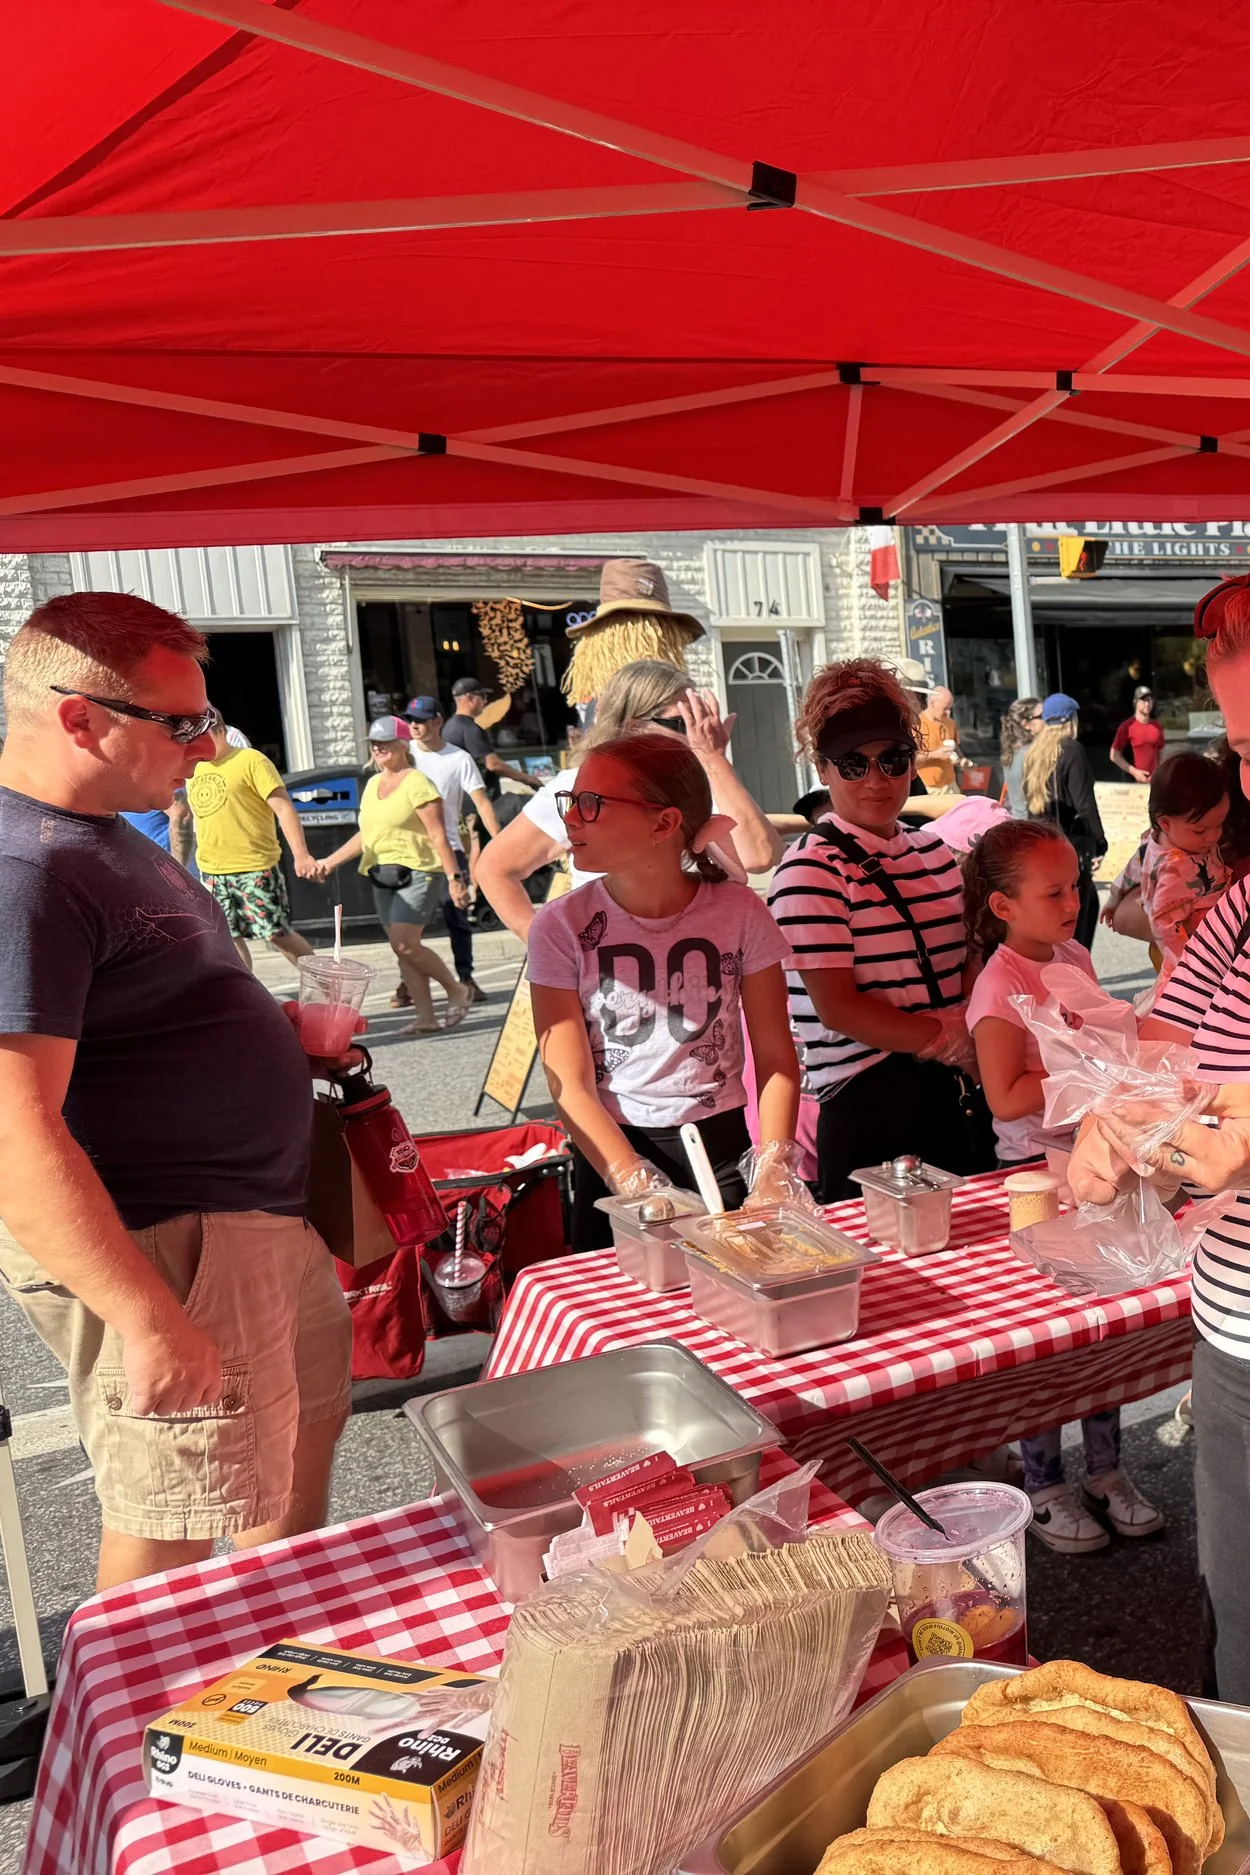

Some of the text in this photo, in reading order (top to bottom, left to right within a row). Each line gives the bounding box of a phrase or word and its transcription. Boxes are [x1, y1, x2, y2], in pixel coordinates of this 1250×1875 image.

[1152, 541, 1231, 556] LIGHTS
[753, 599, 780, 617] 74
[597, 937, 722, 1047] DO
[588, 1463, 641, 1493] BEAVERTAILS
[603, 1481, 656, 1507] BEAVERTAILS
[255, 1663, 293, 1674] RHINO
[262, 1723, 299, 1737] Gloves
[267, 1717, 371, 1743] GANTS DE CHARCUTERIE
[150, 1745, 177, 1765] Rhino
[189, 1741, 267, 1766] Medium Moyen
[291, 1733, 364, 1760] DELI
[398, 1737, 462, 1761] Rhino
[333, 1771, 361, 1786] 200M
[438, 1758, 474, 1793] Medium
[188, 1770, 360, 1815] DELI GLOVES GANTS DE CHARCUTERIE
